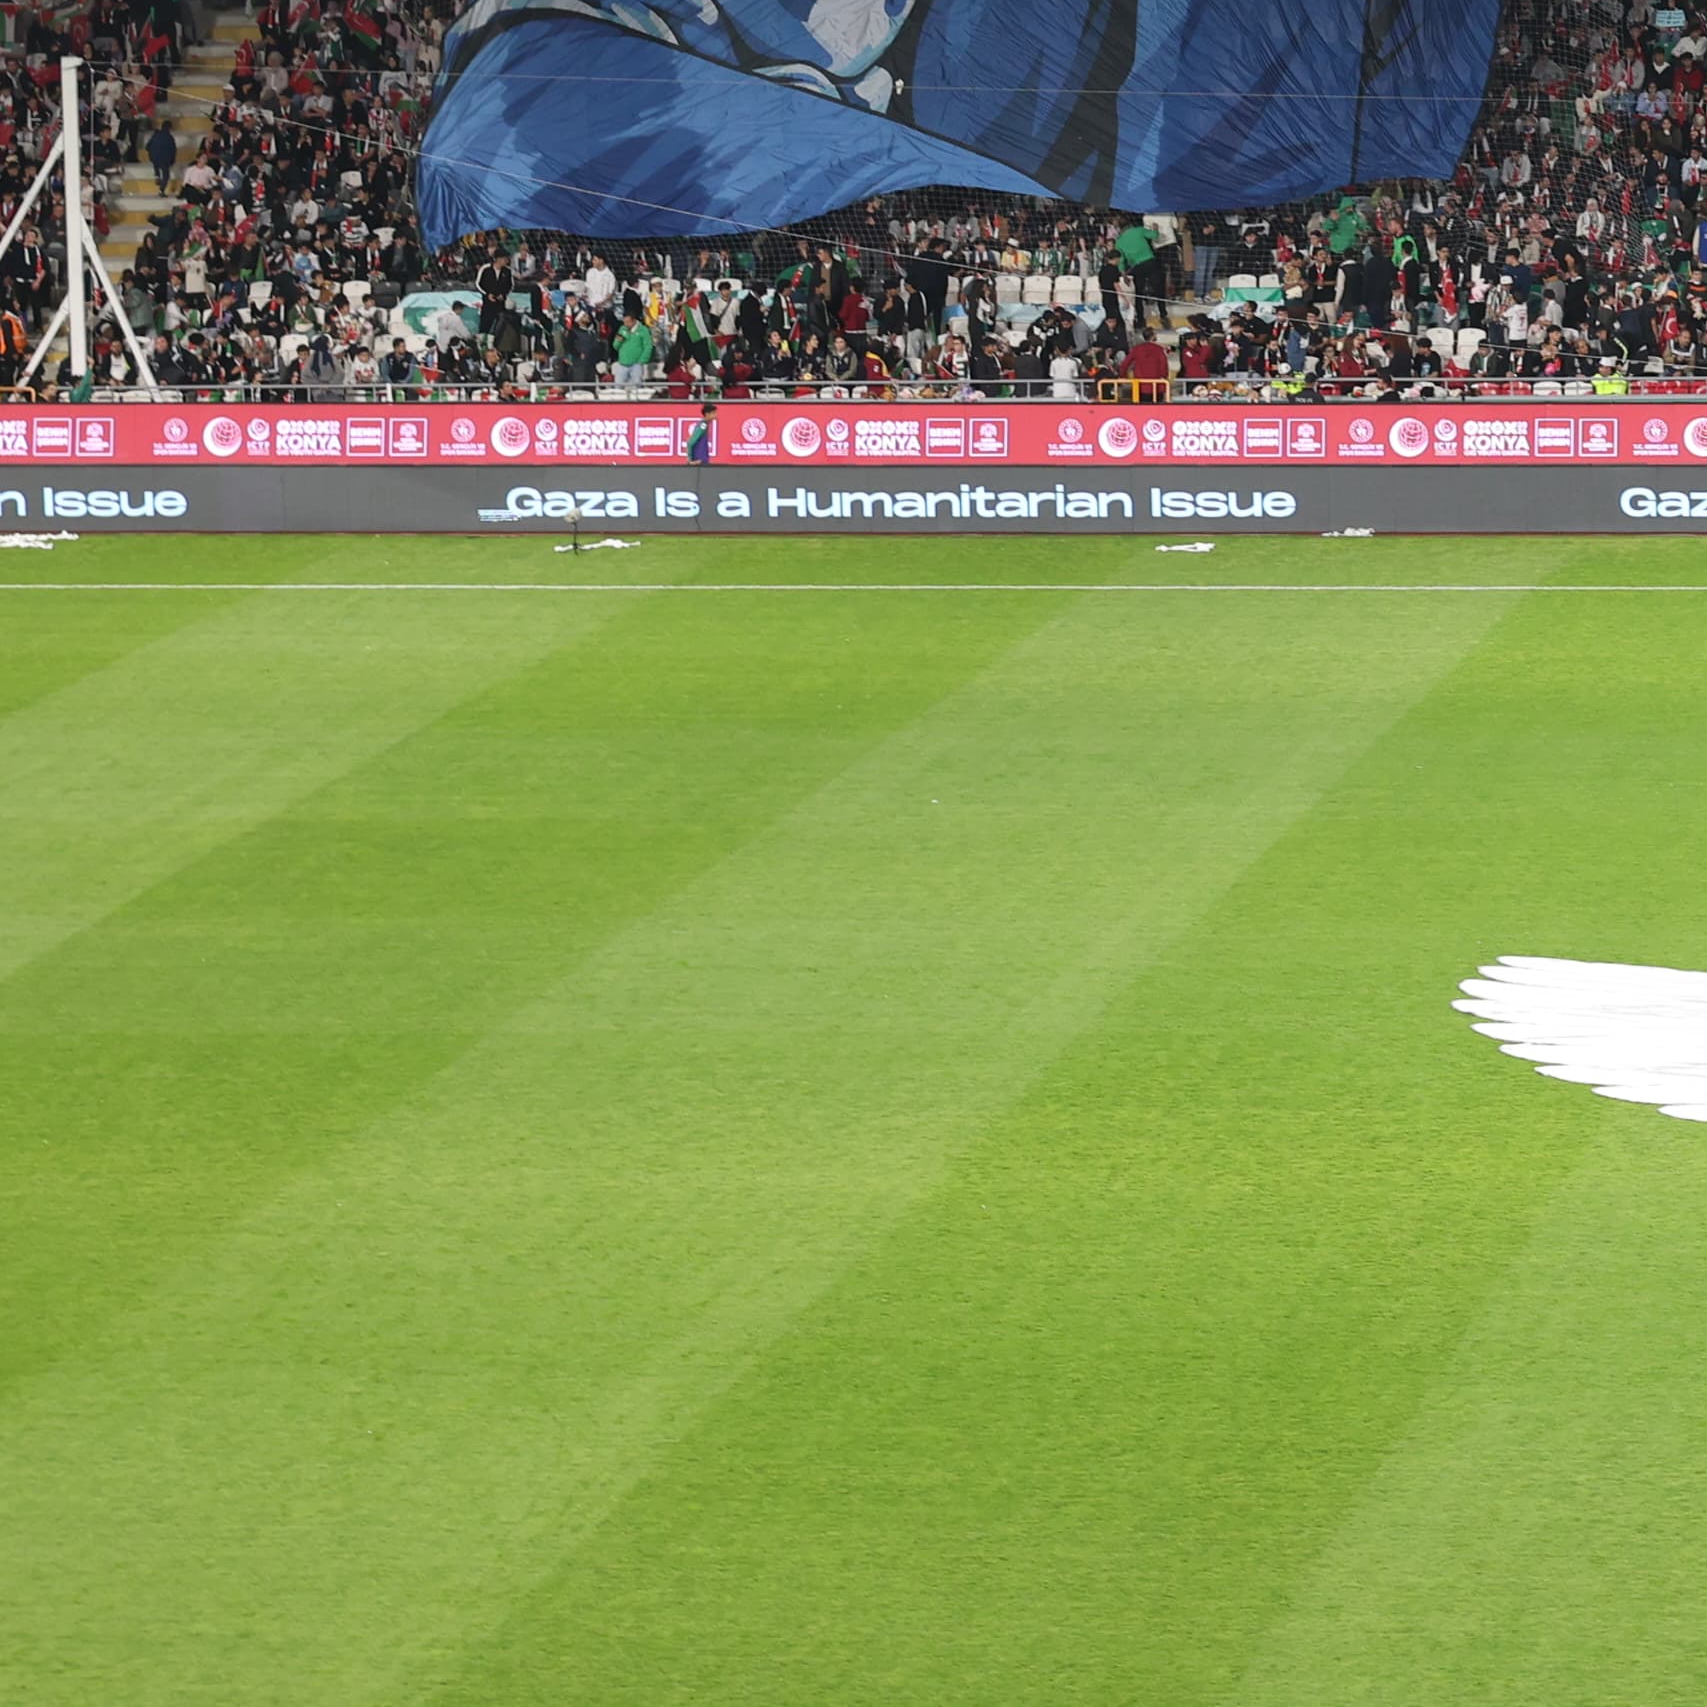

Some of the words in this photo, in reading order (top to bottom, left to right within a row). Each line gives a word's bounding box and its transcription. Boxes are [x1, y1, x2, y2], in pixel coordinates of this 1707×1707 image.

[276, 434, 342, 450] KONYA
[564, 434, 630, 450] KONYA
[855, 434, 921, 450] KONYA
[1173, 435, 1239, 451] KONYA
[1464, 435, 1530, 451] KONYA
[43, 486, 188, 518] Issue
[506, 486, 639, 518] Gaza
[655, 487, 700, 518] Is
[716, 491, 751, 518] a
[767, 483, 1133, 518] Humanitarian
[1150, 487, 1297, 518] Issue
